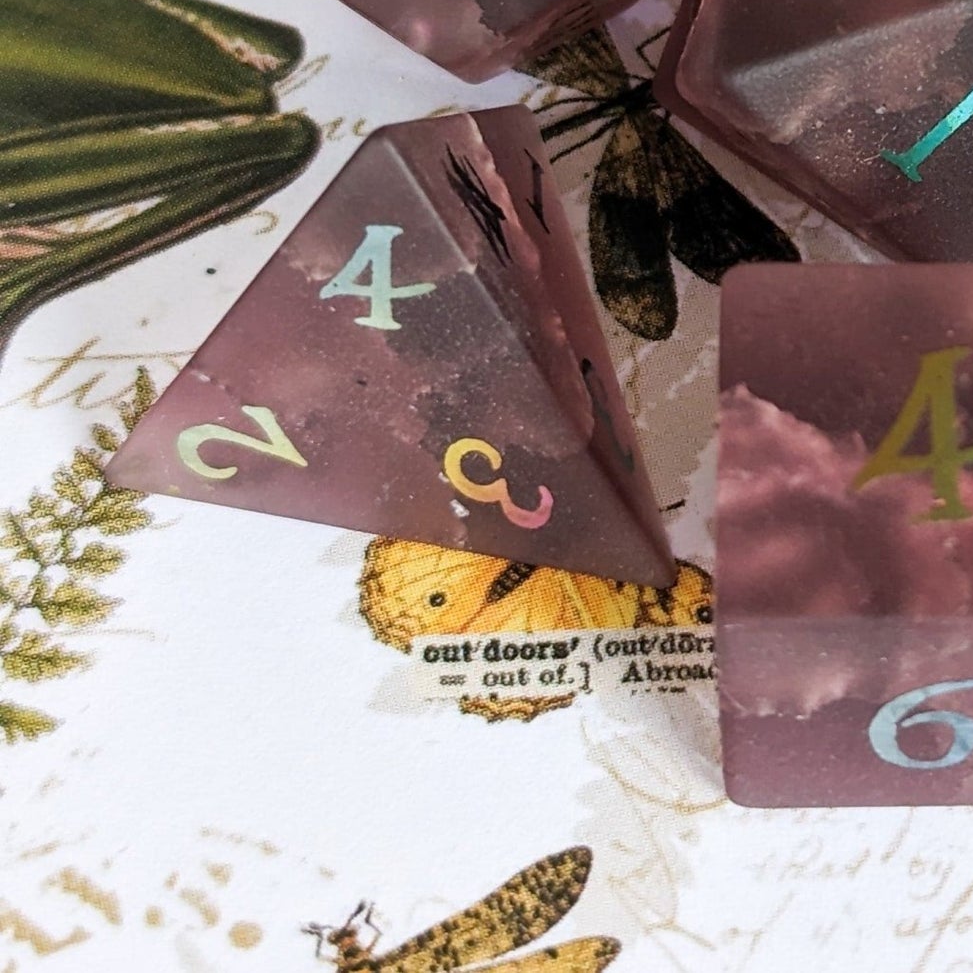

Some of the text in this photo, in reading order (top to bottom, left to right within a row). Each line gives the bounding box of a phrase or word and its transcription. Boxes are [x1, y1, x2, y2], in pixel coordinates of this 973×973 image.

[319, 225, 436, 330] 4
[176, 404, 307, 480] 2
[442, 437, 553, 529] 3
[483, 668, 530, 686] out
